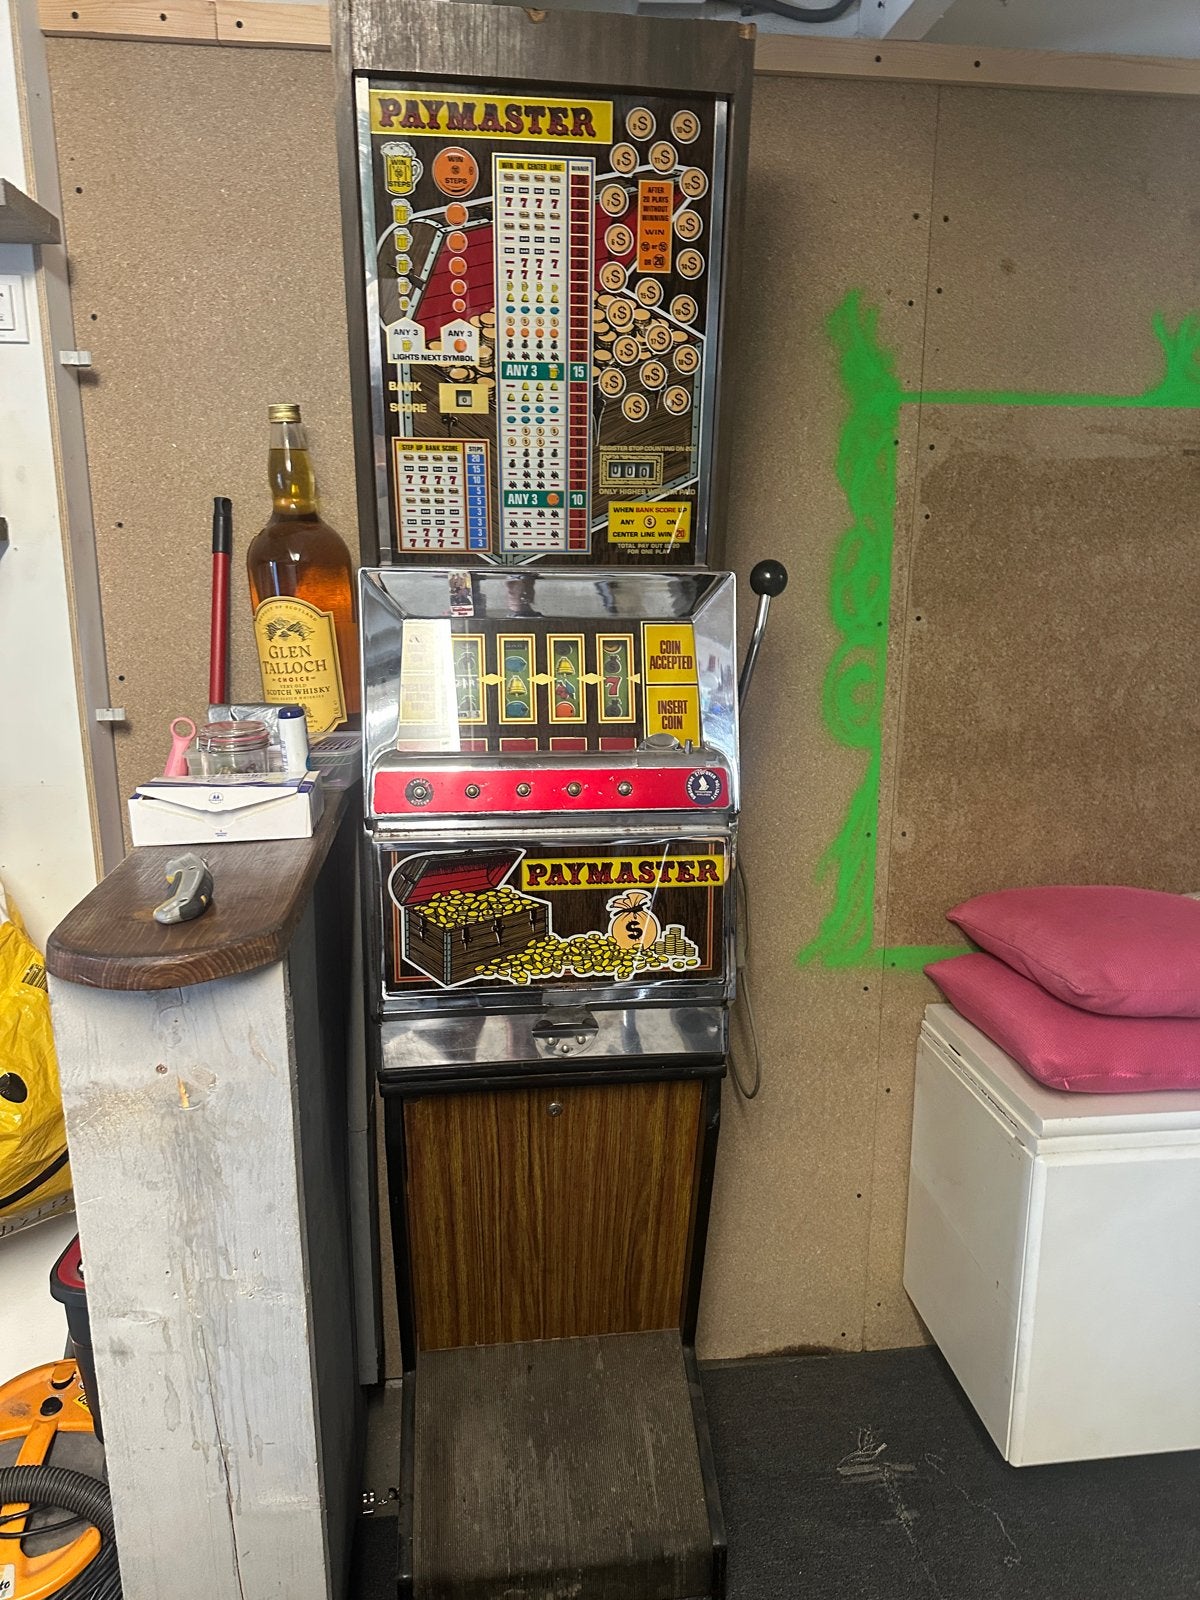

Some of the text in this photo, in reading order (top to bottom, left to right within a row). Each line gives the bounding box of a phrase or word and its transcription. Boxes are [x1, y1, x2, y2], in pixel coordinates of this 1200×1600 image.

[378, 98, 596, 137] PAYMASTER
[506, 364, 584, 377] ANY 3 15
[388, 382, 422, 391] BANK
[390, 403, 427, 412] SCORE
[508, 494, 583, 505] ANY 3 10
[286, 605, 318, 621] SCOTLAND
[269, 645, 312, 658] GLEN
[660, 640, 680, 654] COIN
[262, 659, 327, 674] TALLOCH
[650, 656, 692, 670] ACCEPTED
[295, 686, 330, 695] WHISKY
[658, 700, 688, 714] INSERT
[662, 716, 683, 729] COIN
[527, 859, 720, 886] PAYMASTER
